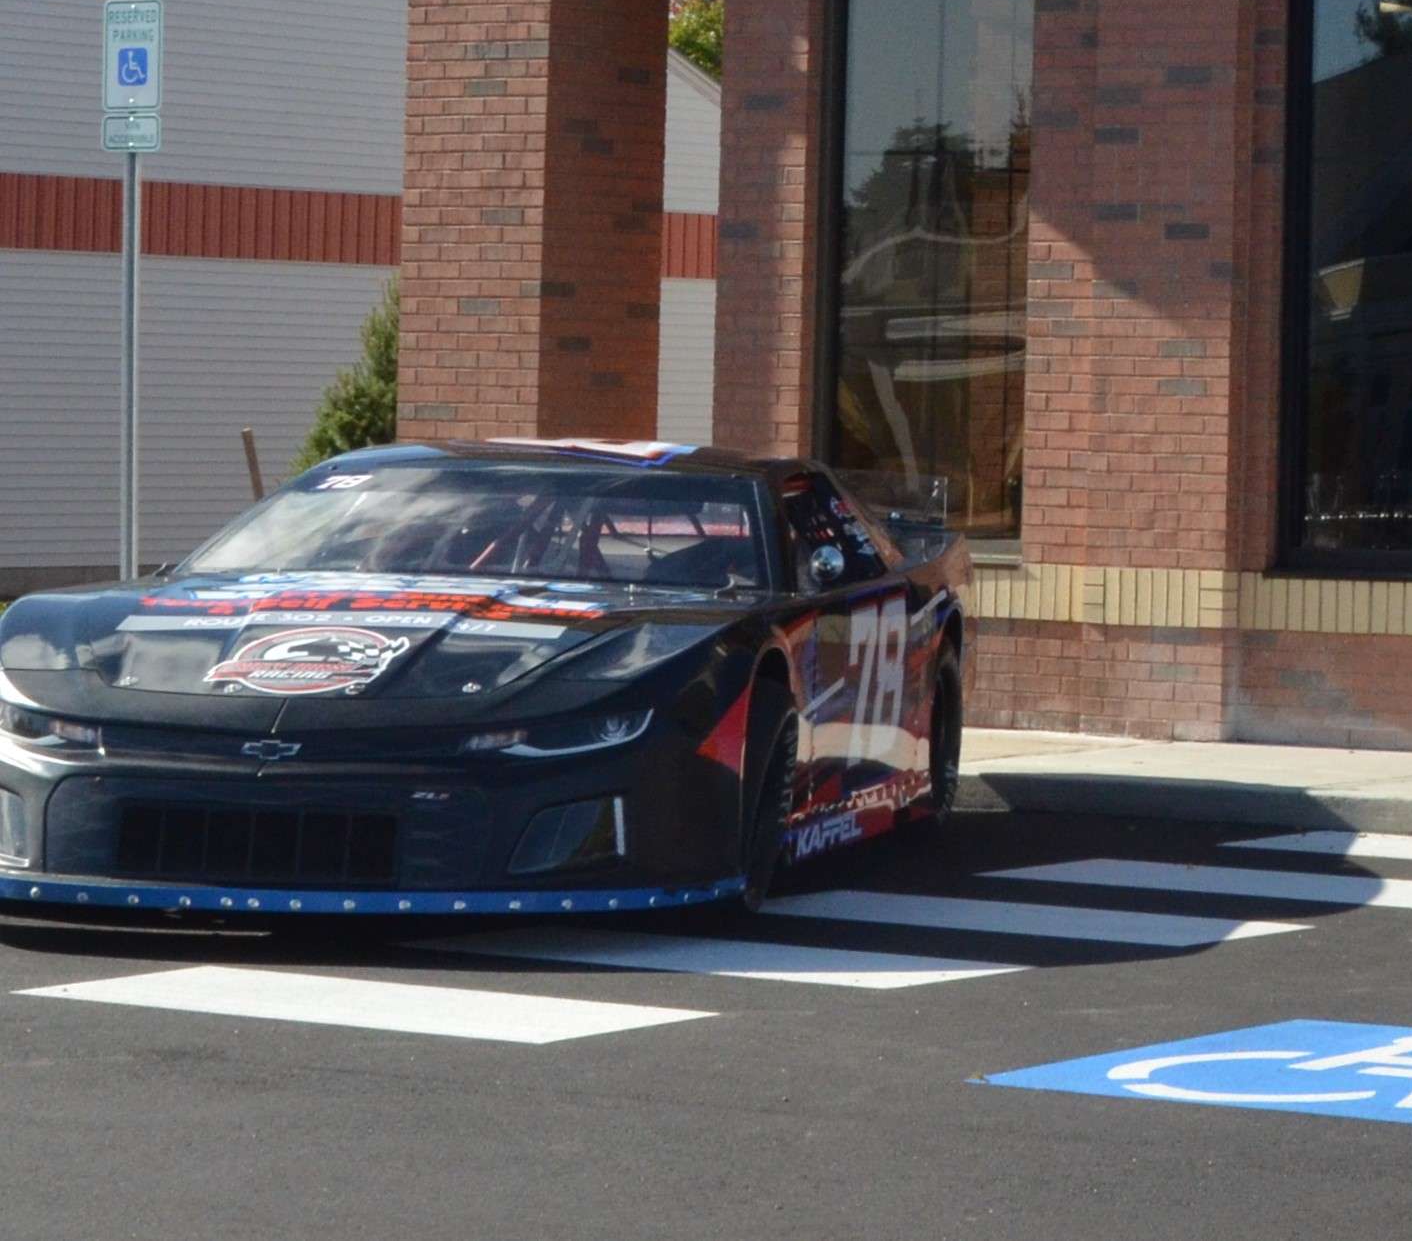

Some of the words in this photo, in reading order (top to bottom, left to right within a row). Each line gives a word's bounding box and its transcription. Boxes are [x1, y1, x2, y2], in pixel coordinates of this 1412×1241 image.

[109, 10, 157, 24] RESERVED
[112, 30, 154, 42] PARKING
[316, 474, 374, 490] 78
[278, 612, 333, 623] 302
[364, 615, 432, 625] OPEN
[248, 670, 334, 680] RACING
[846, 596, 907, 769] 78
